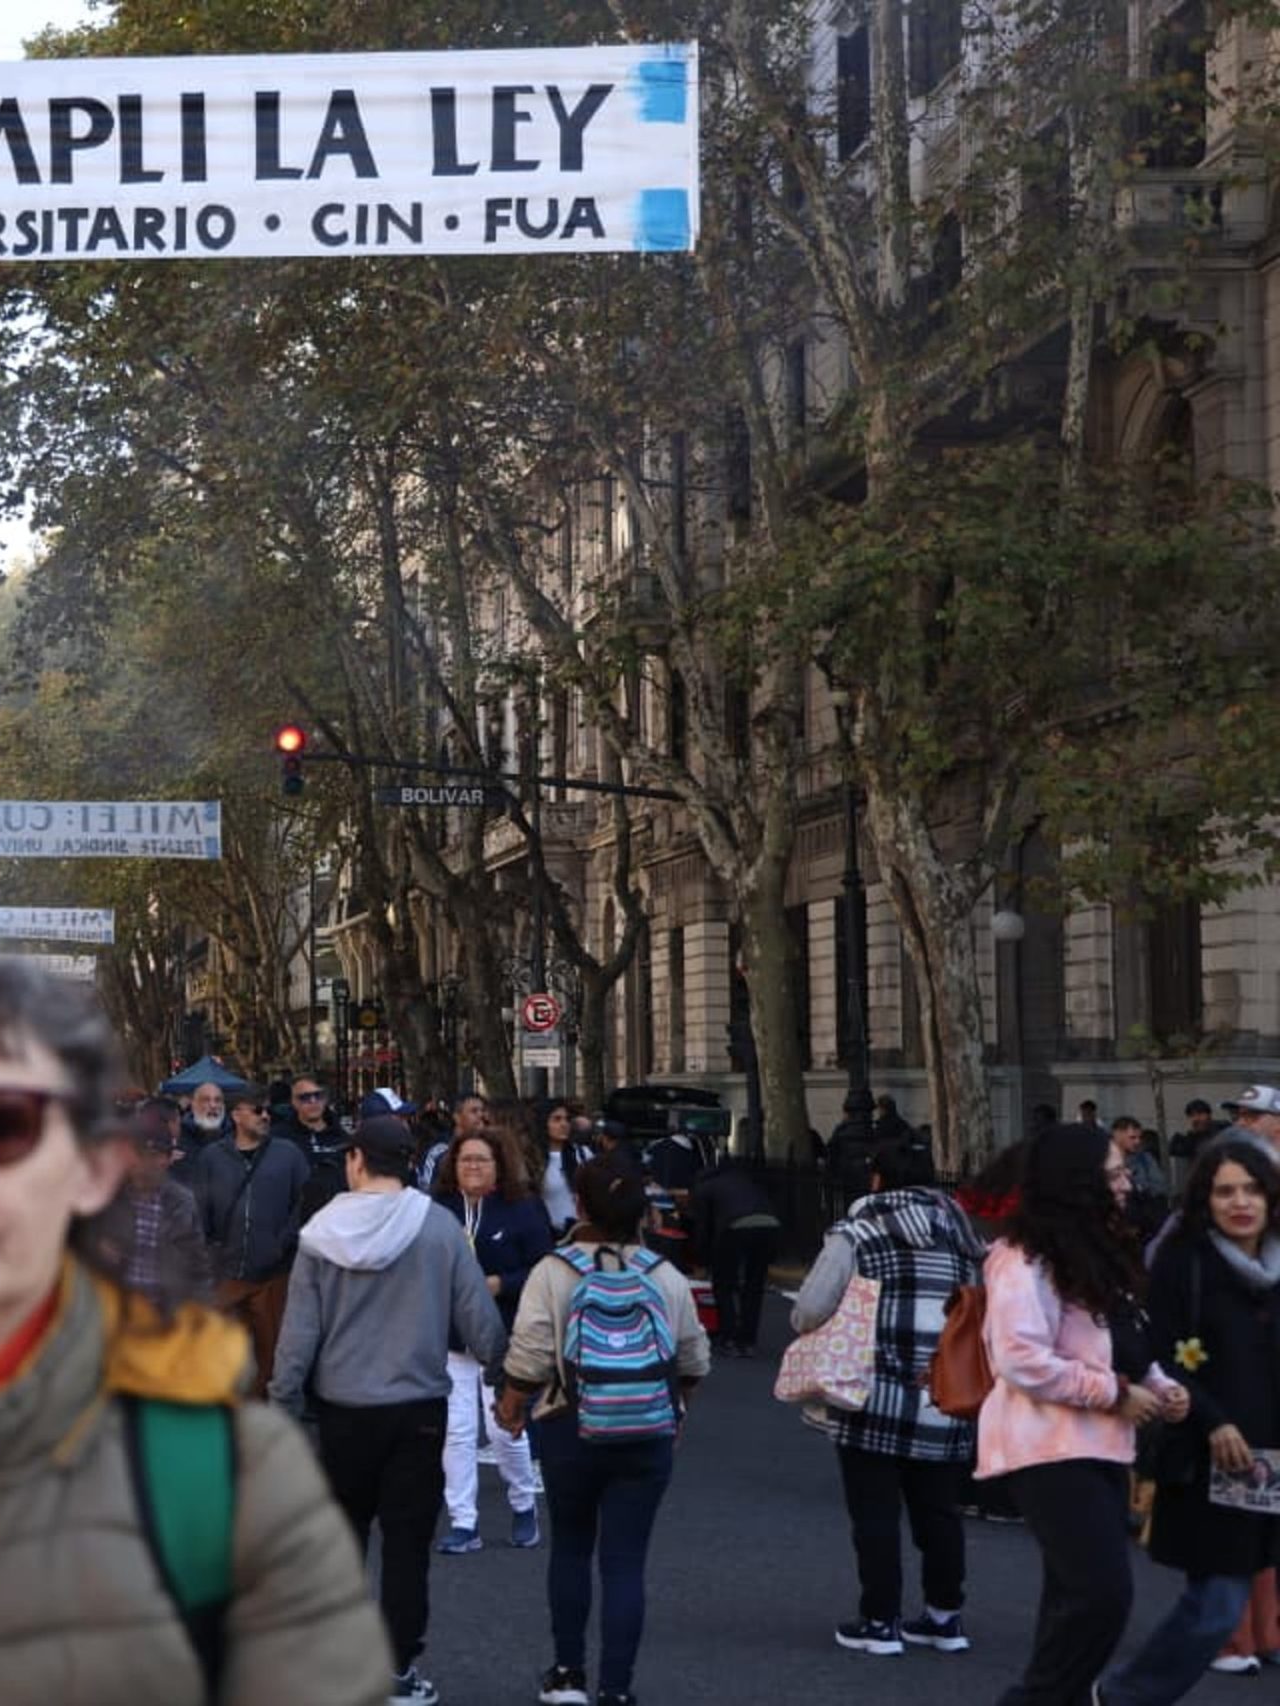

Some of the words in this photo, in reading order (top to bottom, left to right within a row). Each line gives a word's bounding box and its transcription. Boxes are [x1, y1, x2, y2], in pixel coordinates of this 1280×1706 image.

[254, 90, 379, 180] LA
[430, 84, 615, 176] LEY
[311, 202, 423, 247] CIN
[483, 197, 607, 244] FUA
[400, 787, 484, 804] BOLIVAR
